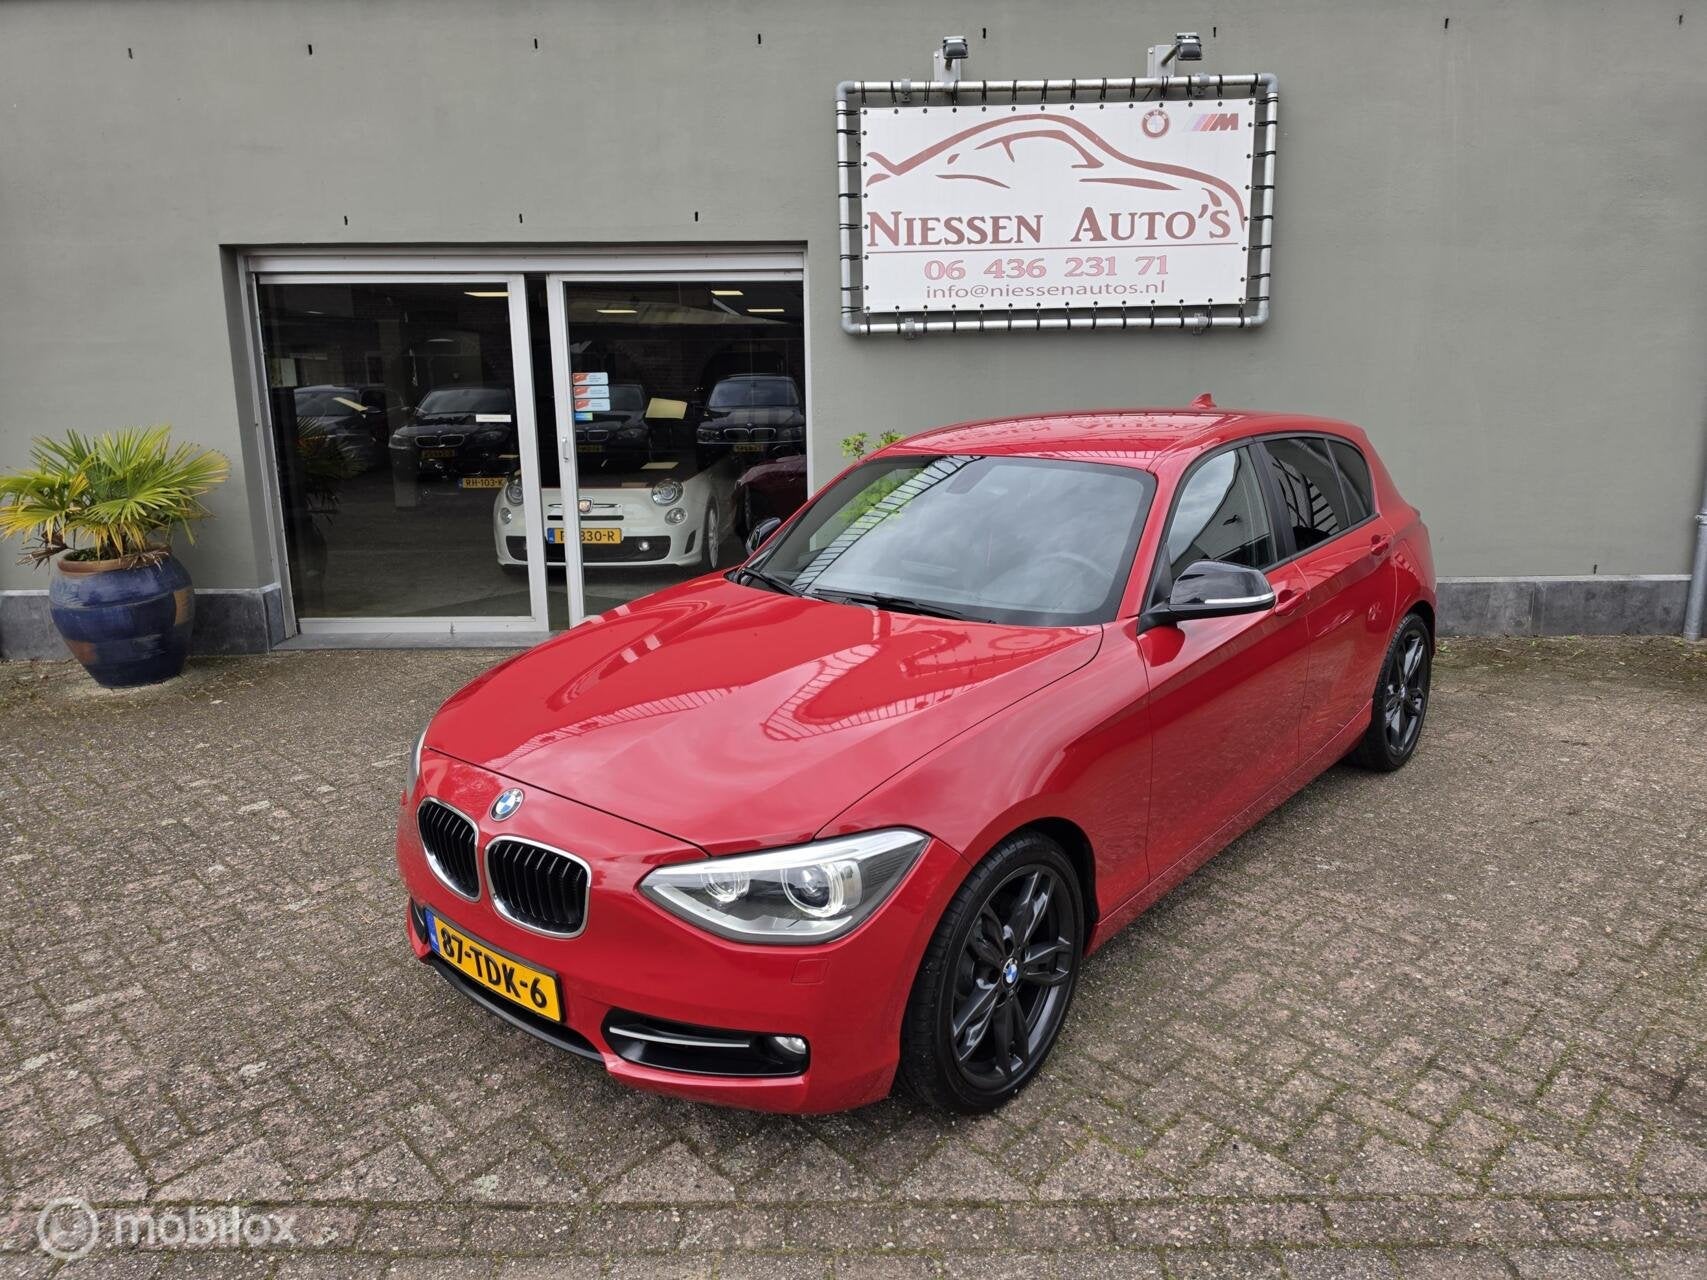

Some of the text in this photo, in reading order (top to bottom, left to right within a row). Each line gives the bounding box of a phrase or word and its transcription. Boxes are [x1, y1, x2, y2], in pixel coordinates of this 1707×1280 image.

[924, 254, 1168, 280] 06 436 231 71
[926, 280, 1166, 299] info@niessenautos.nl
[440, 926, 548, 1009] 87-TDK-6
